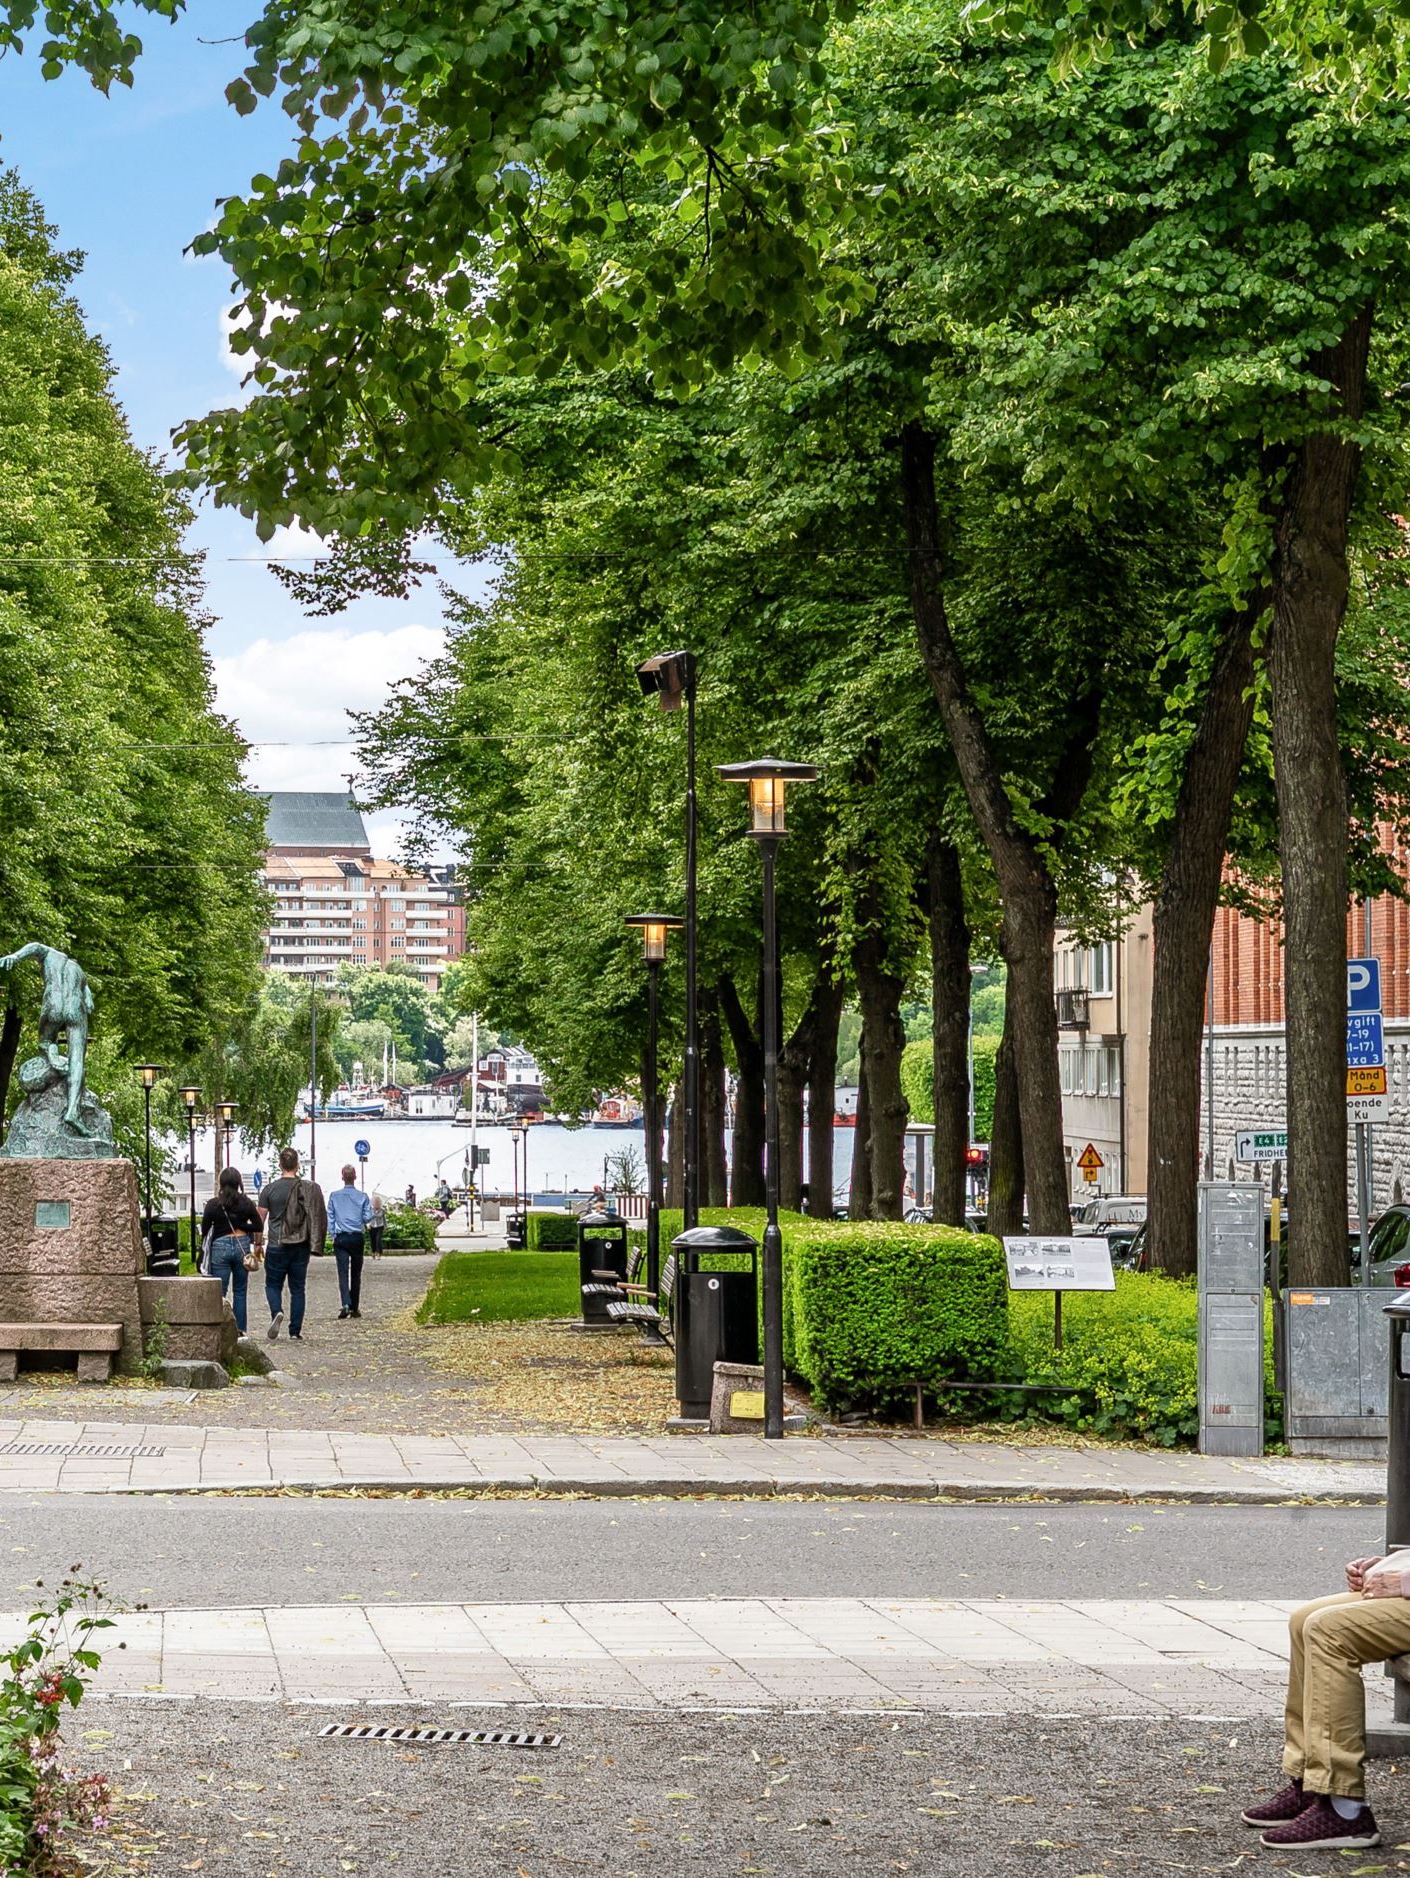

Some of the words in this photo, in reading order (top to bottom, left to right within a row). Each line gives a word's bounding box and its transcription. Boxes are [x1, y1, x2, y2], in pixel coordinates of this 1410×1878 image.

[1347, 965, 1371, 1007] P
[1372, 1054, 1379, 1063] 3
[1350, 1071, 1380, 1080] Månd
[1354, 1082, 1376, 1092] 0-6
[1354, 1110, 1368, 1119] Ku
[1254, 1149, 1287, 1158] FRIDHE
